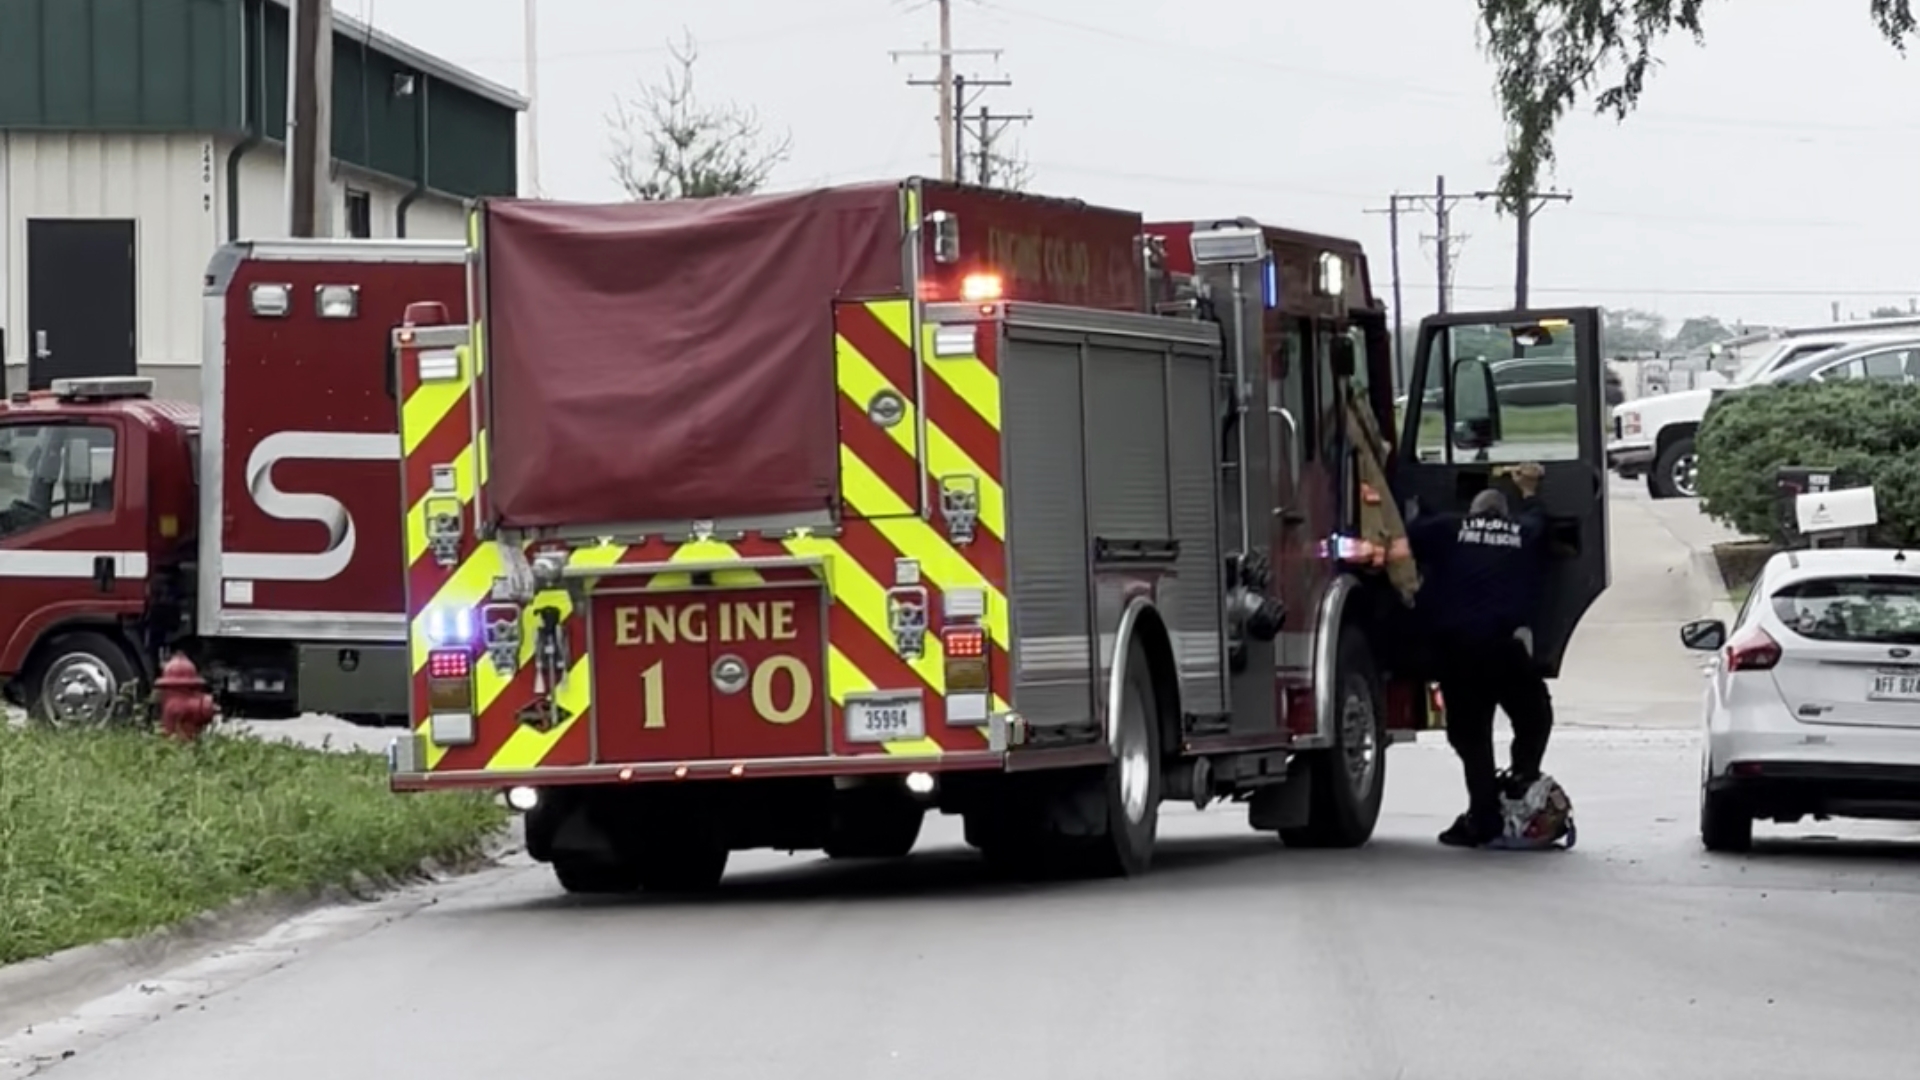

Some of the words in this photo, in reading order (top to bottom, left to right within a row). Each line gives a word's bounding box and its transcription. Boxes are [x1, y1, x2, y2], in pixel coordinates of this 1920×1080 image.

[1462, 518, 1521, 535] LINCOLN
[1458, 530, 1481, 544] FIRE
[1483, 531, 1522, 549] RESCUE
[615, 601, 797, 645] ENGINE
[865, 709, 908, 730] 35994
